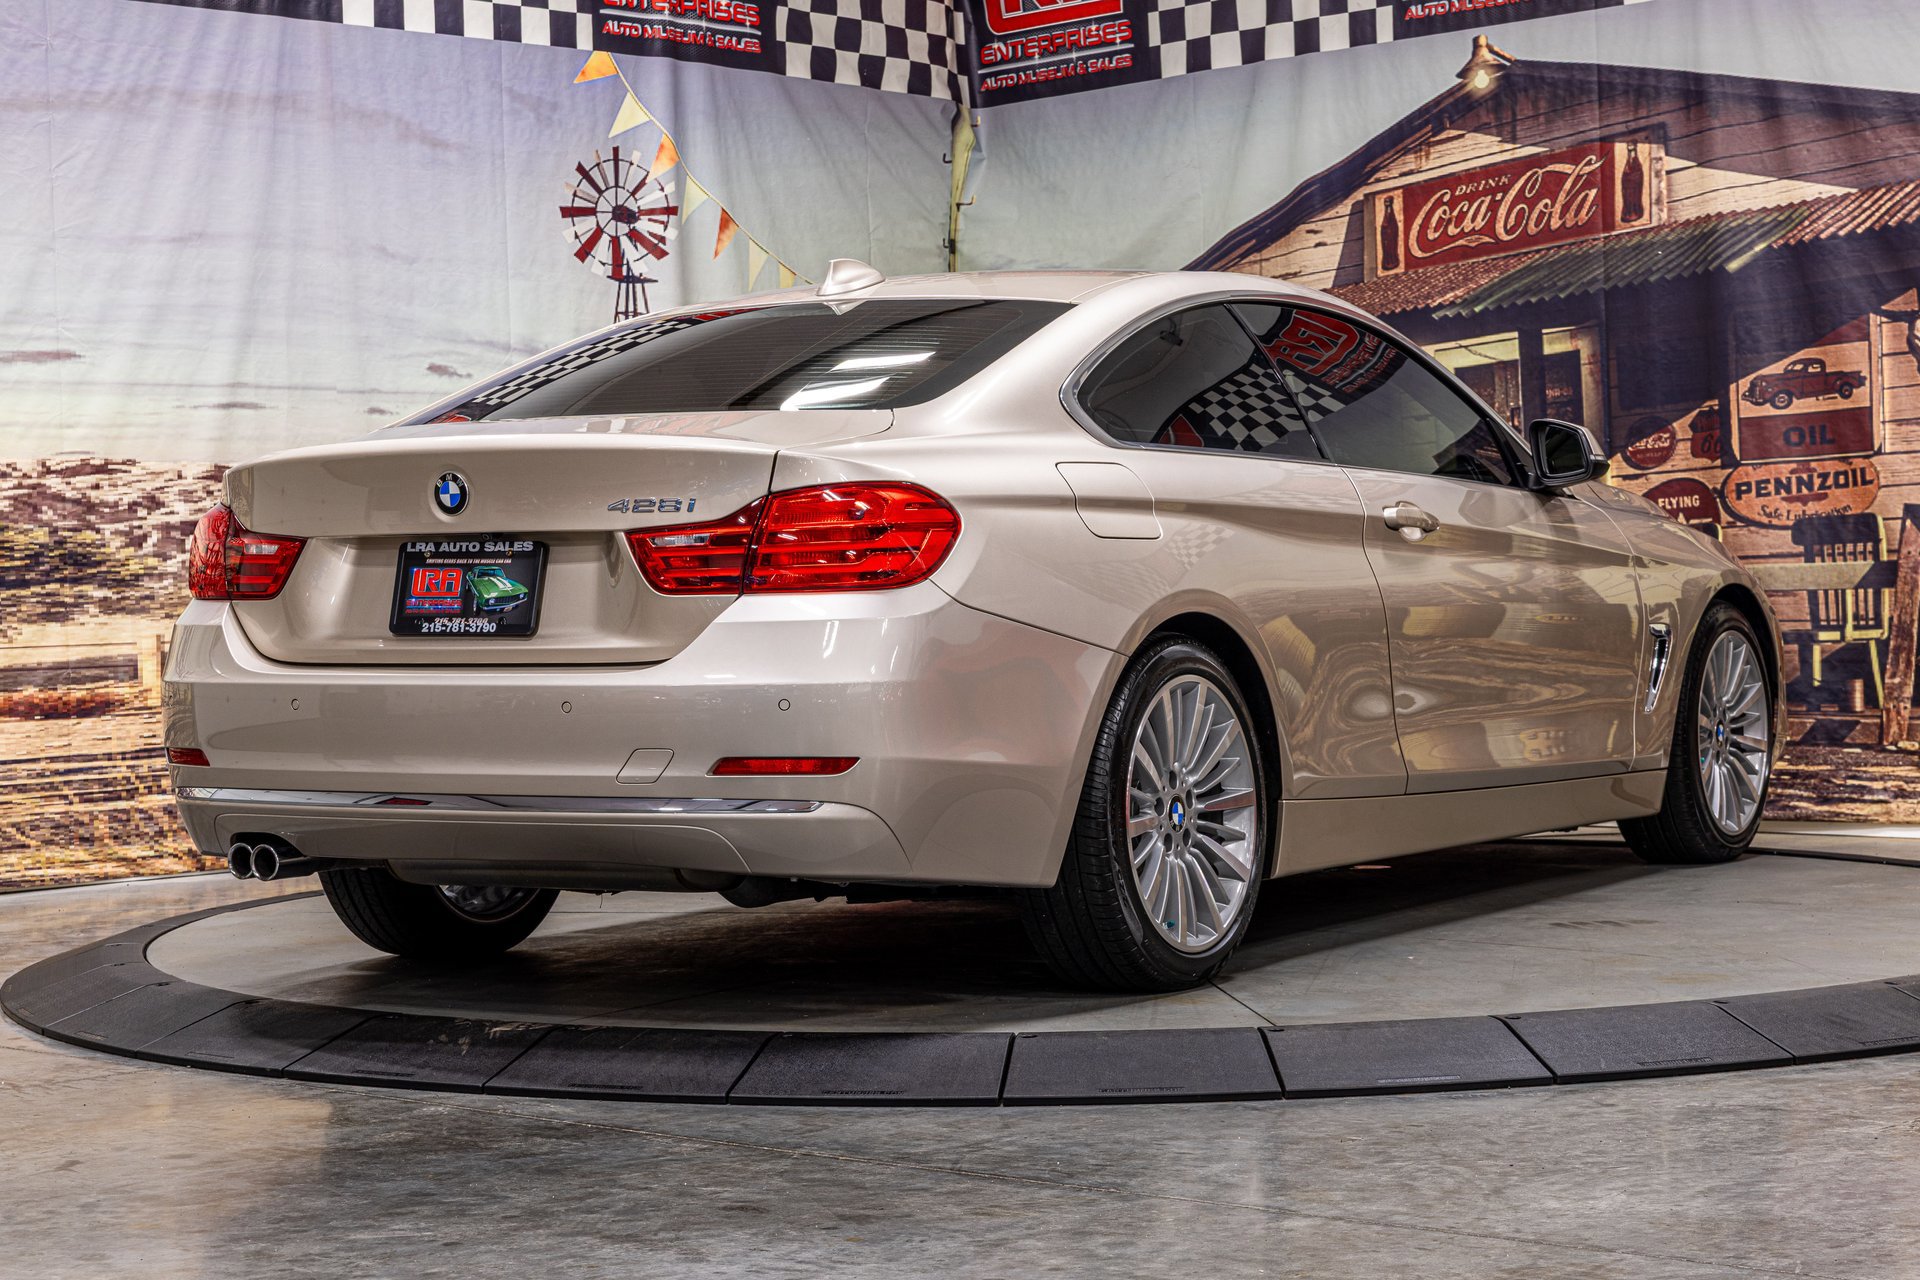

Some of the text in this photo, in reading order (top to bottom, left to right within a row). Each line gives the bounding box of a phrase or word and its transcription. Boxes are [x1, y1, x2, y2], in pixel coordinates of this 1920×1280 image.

[602, 0, 761, 26] ERPRISES
[1404, 0, 1520, 21] AUTO MUSE
[602, 20, 762, 54] AUTO MUSEUM & SALES
[980, 19, 1133, 65] ENTERPRISES
[980, 53, 1134, 92] AUTO MUSEUM & SALES
[1455, 173, 1512, 196] DRINK
[1783, 423, 1836, 448] OIL
[436, 473, 464, 488] BMW
[1735, 466, 1875, 501] PENNZOIL
[607, 497, 696, 513] 428i
[1658, 494, 1700, 510] FLYING
[1758, 504, 1784, 521] Safe
[407, 541, 533, 552] LRA AUTO SALES
[410, 567, 463, 597] LRA
[421, 622, 496, 632] 215-781-3790
